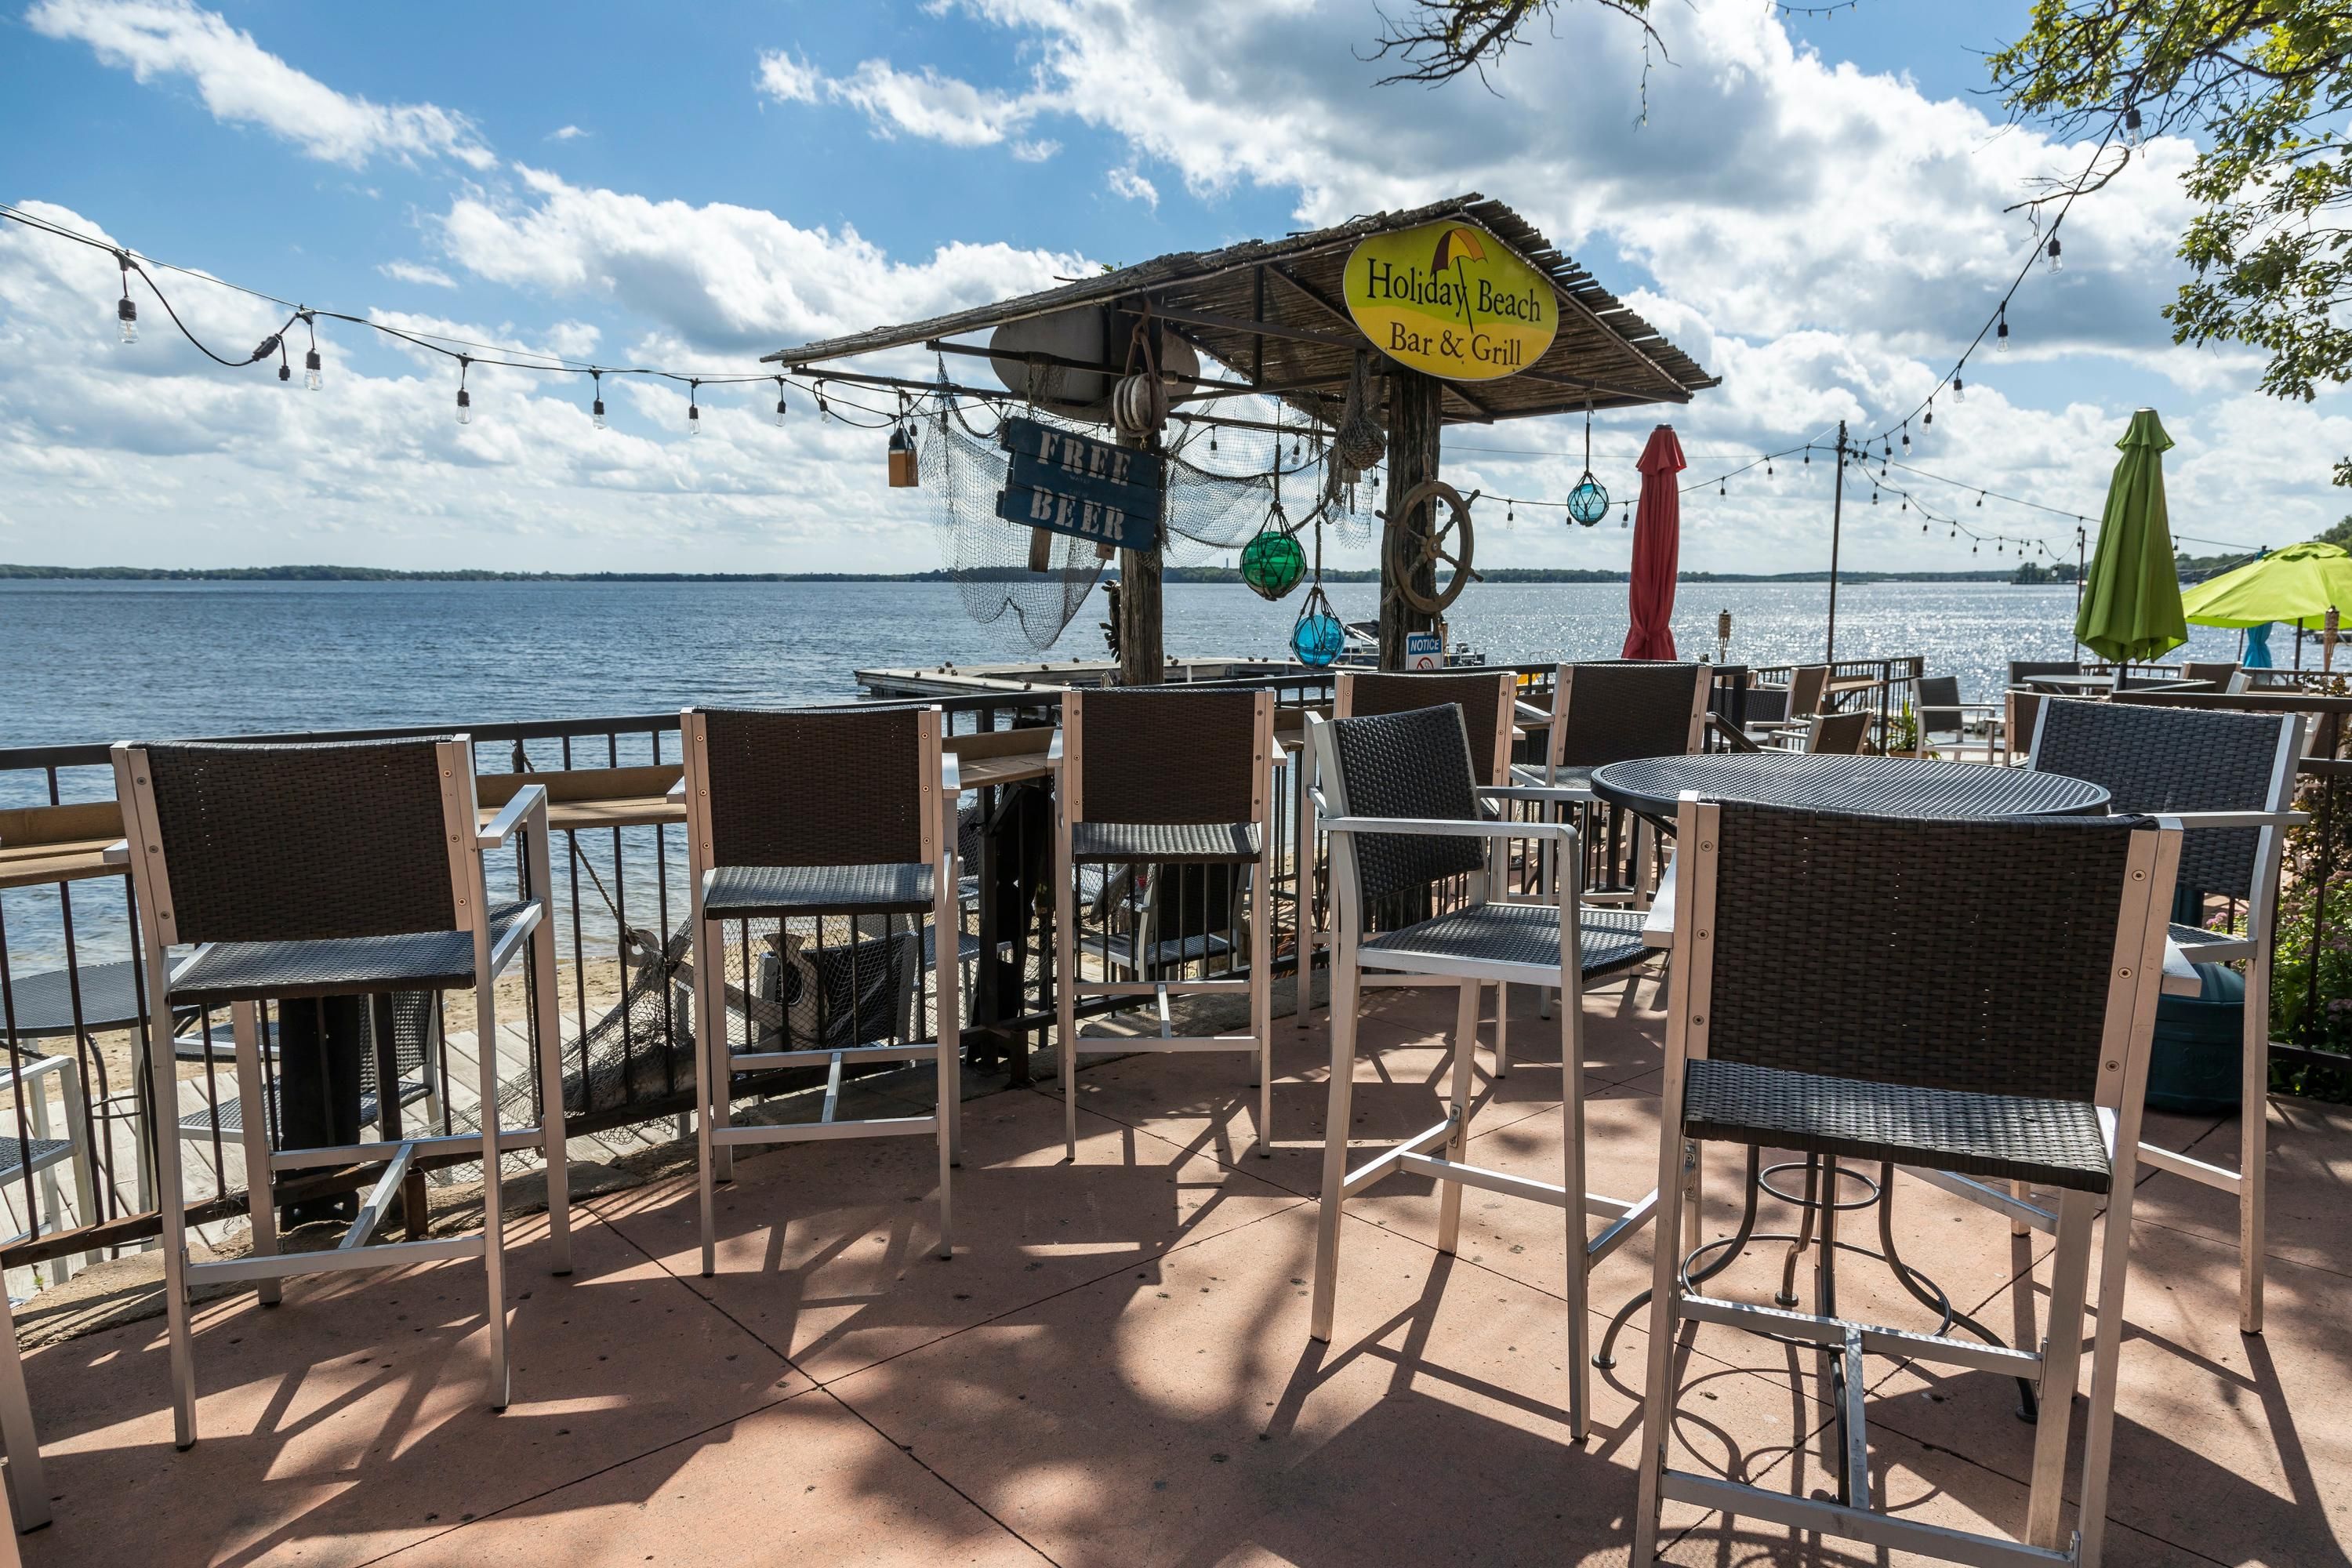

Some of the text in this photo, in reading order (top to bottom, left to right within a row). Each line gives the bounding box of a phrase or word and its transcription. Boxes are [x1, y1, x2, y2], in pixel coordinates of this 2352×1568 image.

[1367, 258, 1541, 322] Holiday Beach
[1388, 321, 1522, 366] Bar & Grill
[1036, 430, 1131, 486] FREE
[1029, 485, 1125, 541] BEER
[1410, 638, 1439, 652] NOTICE
